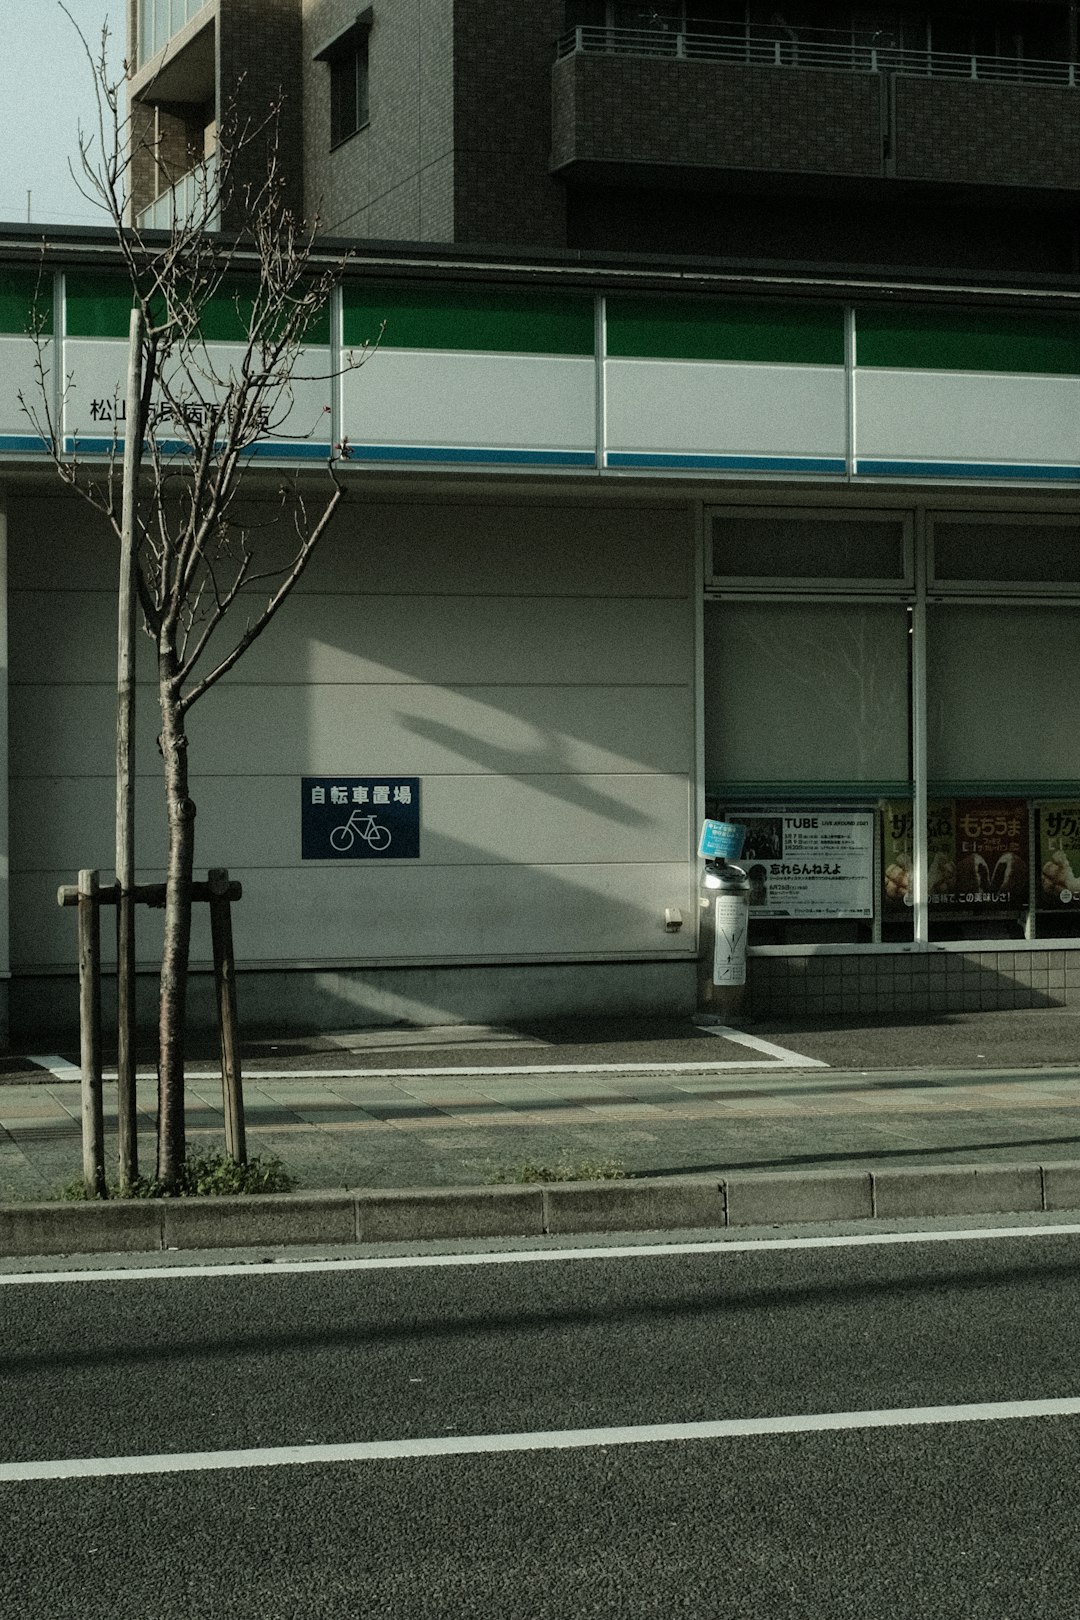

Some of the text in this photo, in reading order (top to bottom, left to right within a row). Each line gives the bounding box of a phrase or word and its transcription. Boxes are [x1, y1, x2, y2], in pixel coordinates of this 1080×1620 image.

[311, 785, 412, 805] 自転車置場
[784, 817, 819, 829] TUBE
[959, 813, 1021, 838] もちうま
[1045, 812, 1080, 837] サク
[769, 863, 841, 875] 忘れらんねえよ
